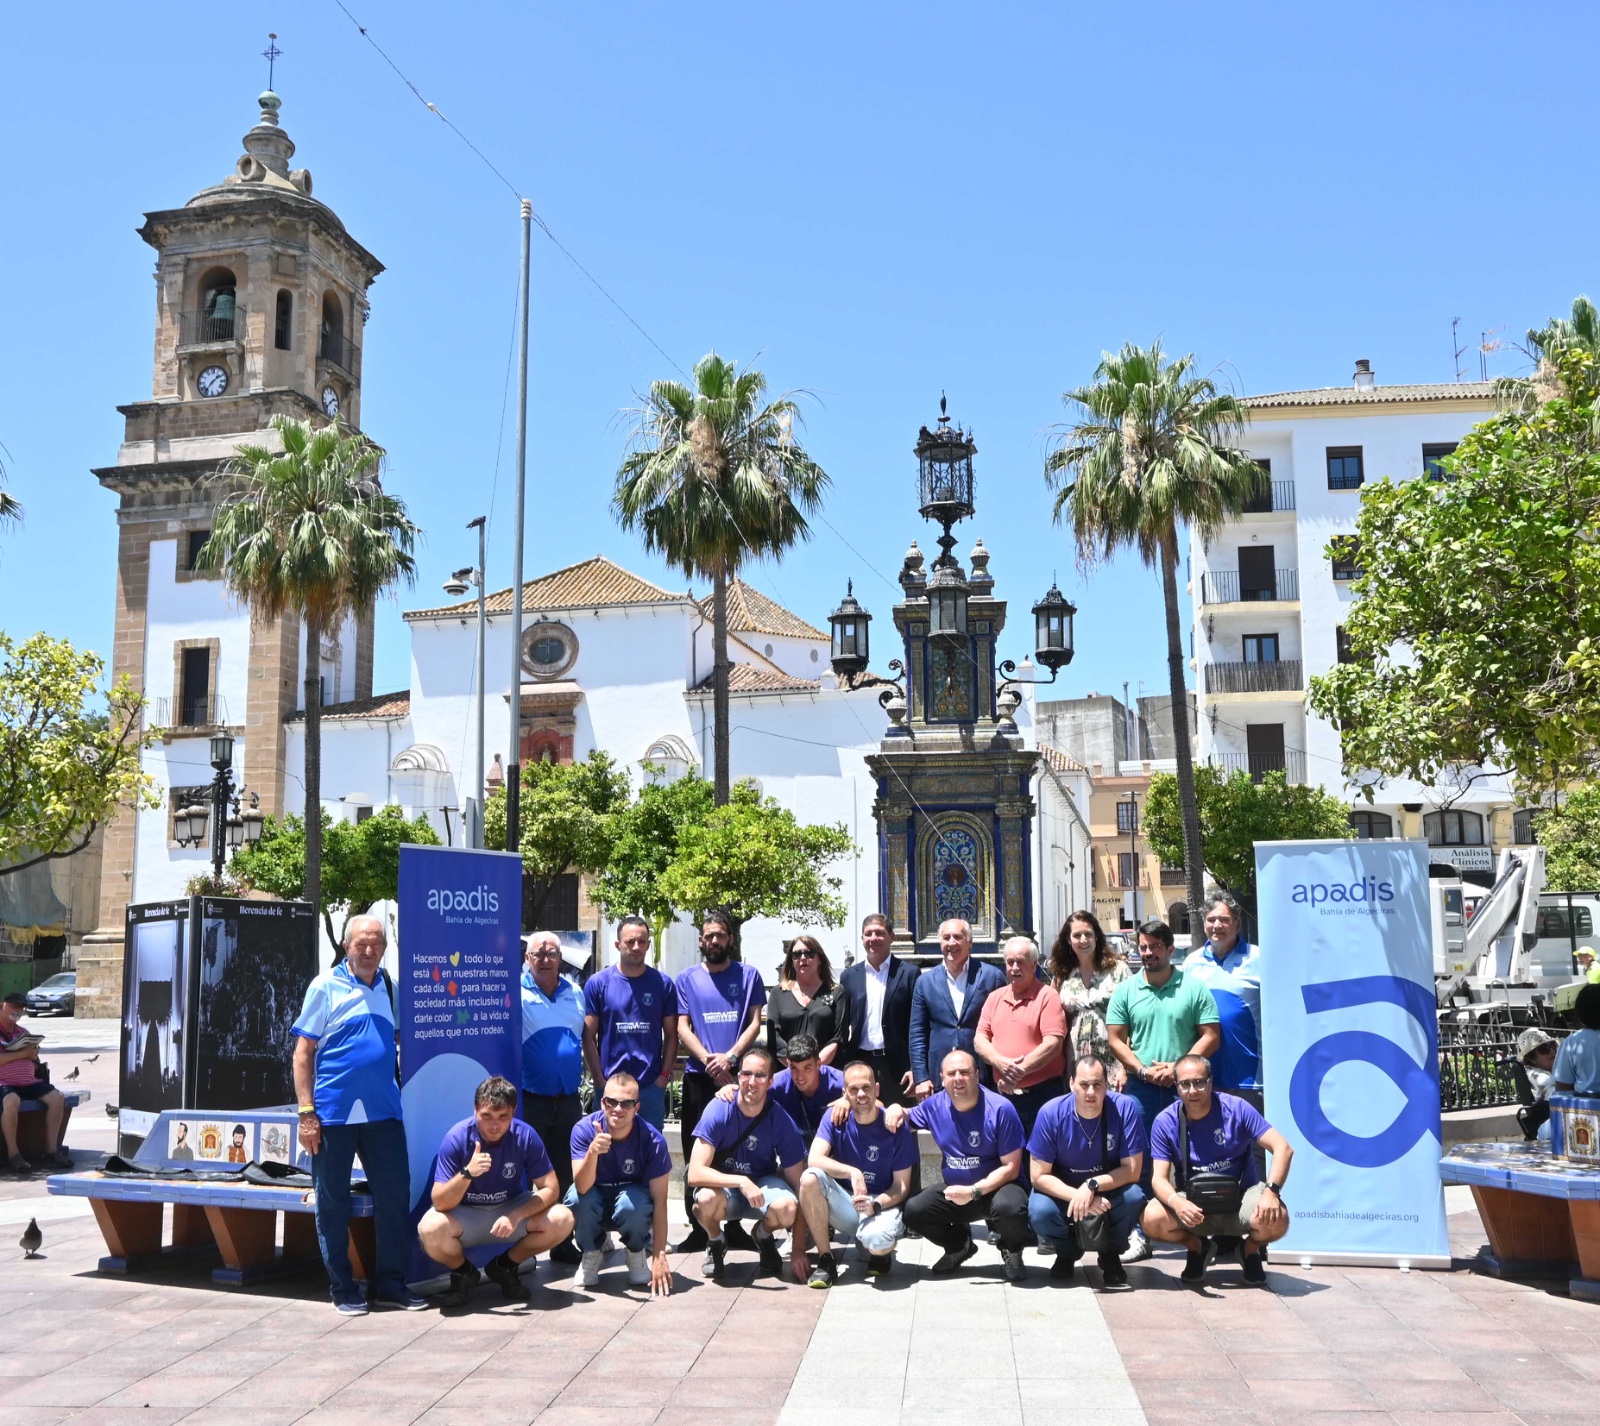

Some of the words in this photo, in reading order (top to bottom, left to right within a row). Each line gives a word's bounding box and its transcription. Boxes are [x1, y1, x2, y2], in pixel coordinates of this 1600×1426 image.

[1452, 858, 1490, 866] Clínicos
[1292, 876, 1394, 908] apadis
[427, 884, 499, 916] apadis
[240, 906, 267, 915] Herencia
[268, 906, 276, 916] de
[276, 906, 282, 916] fe
[1358, 907, 1395, 916] Algeciras
[446, 916, 463, 924] Bahía
[474, 916, 498, 925] Algeciras
[413, 954, 447, 963] Hacemos
[464, 954, 483, 963] todo
[485, 954, 492, 963] lo
[493, 956, 503, 966] que
[413, 968, 429, 978] está
[454, 969, 488, 978] nuestras
[414, 984, 432, 993] cada
[433, 983, 444, 992] día
[462, 984, 480, 995] para
[482, 982, 500, 992] hacer
[501, 983, 506, 992] la
[414, 998, 446, 1008] sociedad
[449, 997, 466, 1007] más
[469, 996, 499, 1007] inclusiva
[414, 1014, 432, 1024] darle
[434, 1013, 452, 1023] color
[480, 1012, 488, 1020] la
[489, 1011, 502, 1020] vida
[503, 1011, 510, 1020] de
[615, 1022, 650, 1030] TeamWork
[414, 1028, 444, 1040] aquellos
[446, 1029, 461, 1040] que
[464, 1028, 478, 1036] nos
[466, 1190, 508, 1200] TeamWork
